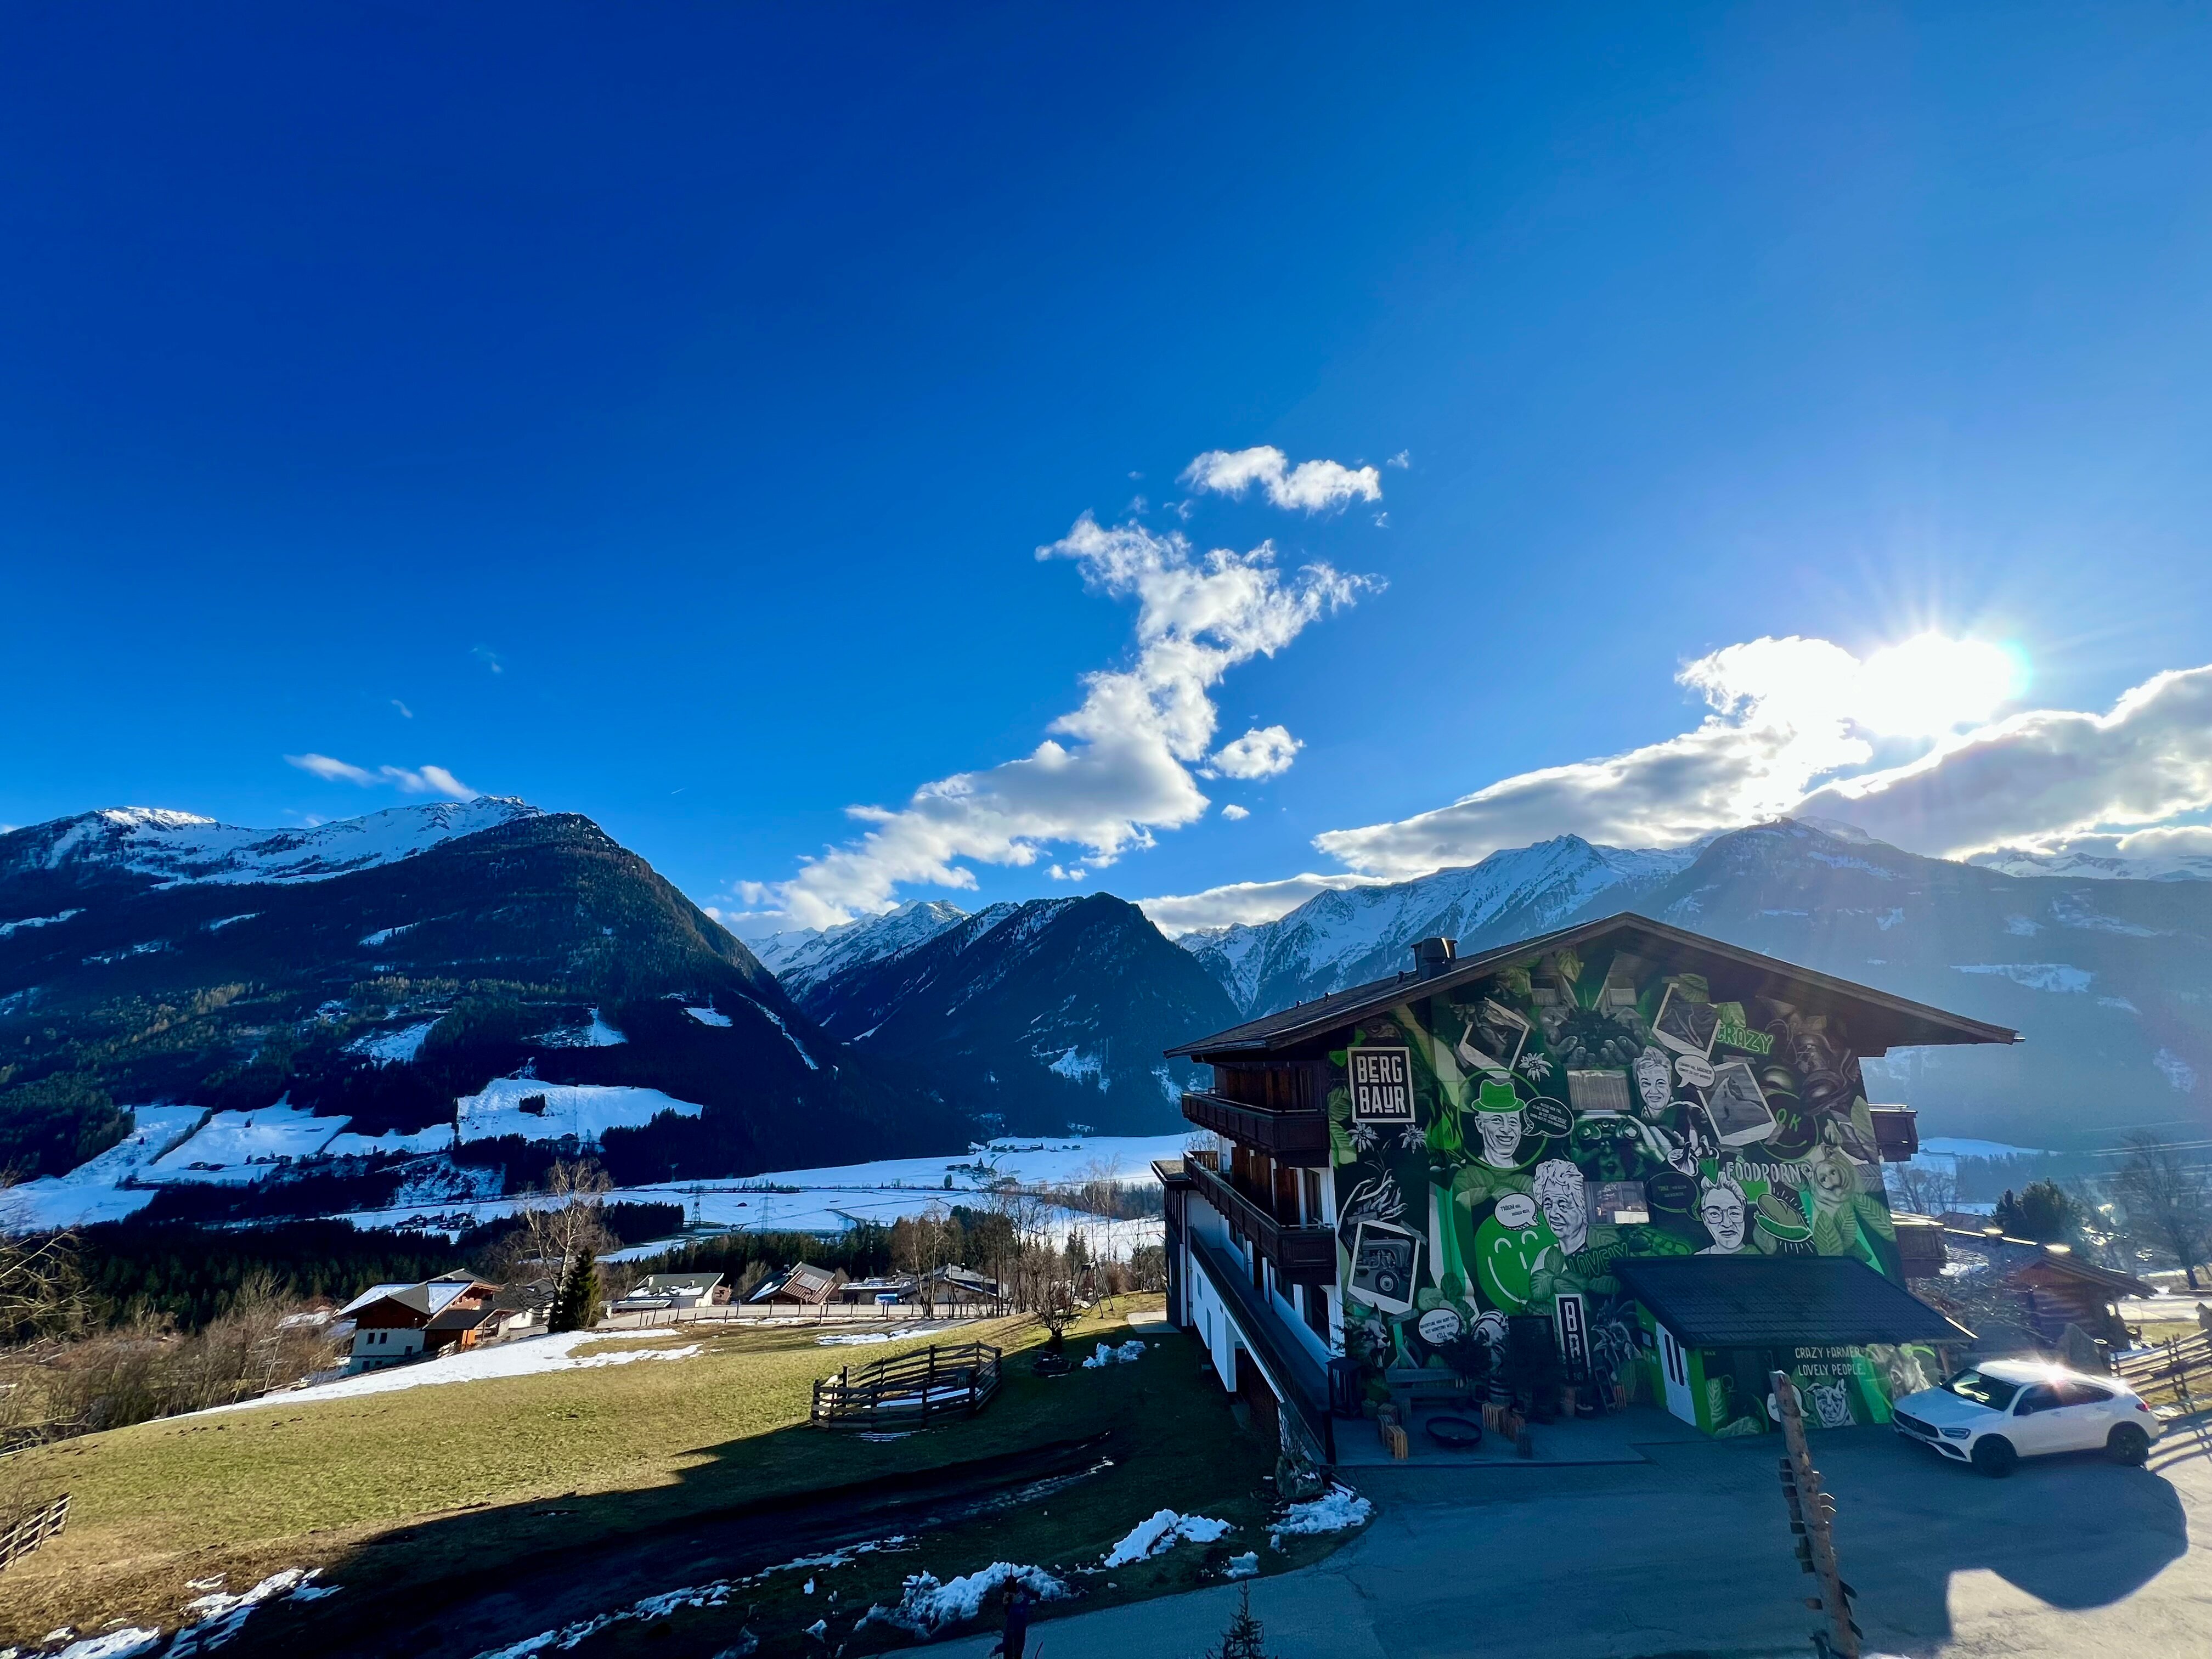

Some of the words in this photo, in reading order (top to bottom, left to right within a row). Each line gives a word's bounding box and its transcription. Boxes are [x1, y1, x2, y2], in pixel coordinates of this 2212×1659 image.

[1715, 1024, 1774, 1054] CRAZY
[1356, 1056, 1403, 1083] BERG
[1358, 1086, 1406, 1113] BAUR
[1725, 1161, 1802, 1183] FOODPORN
[1568, 1242, 1629, 1278] LOVEY
[1795, 1346, 1823, 1359] CRAZY
[1797, 1364, 1829, 1376] LOVELY
